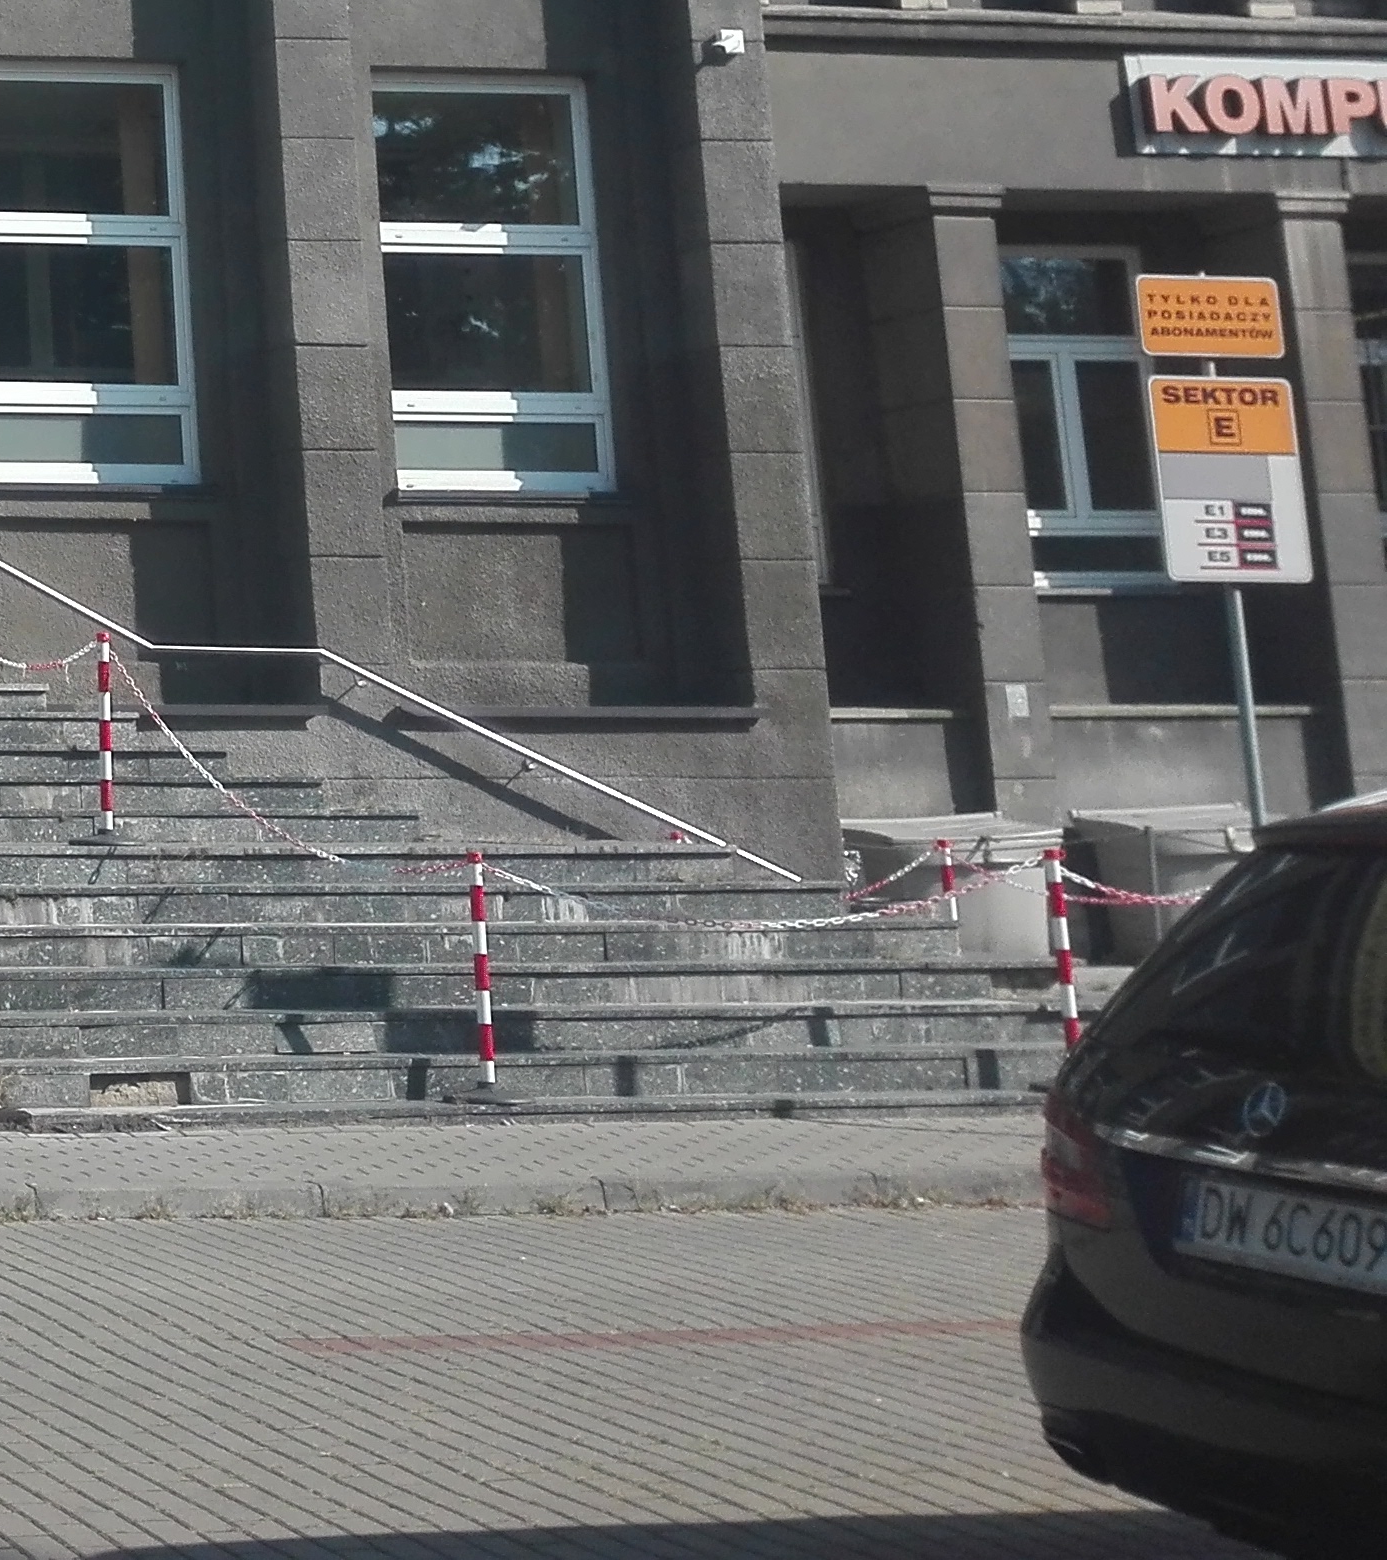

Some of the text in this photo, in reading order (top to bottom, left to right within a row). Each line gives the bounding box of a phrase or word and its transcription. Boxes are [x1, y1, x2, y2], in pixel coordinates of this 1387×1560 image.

[1147, 293, 1270, 307] TYLKO DLA
[1147, 309, 1271, 321] POSIADACZY
[1151, 326, 1273, 339] ABONAMENTÓW
[1162, 385, 1279, 408] SEKTOR
[1213, 416, 1236, 438] E
[1204, 504, 1224, 516] E1
[1205, 527, 1228, 539] E3
[1208, 550, 1231, 562] E5
[1199, 1186, 1387, 1273] DW 6C609
